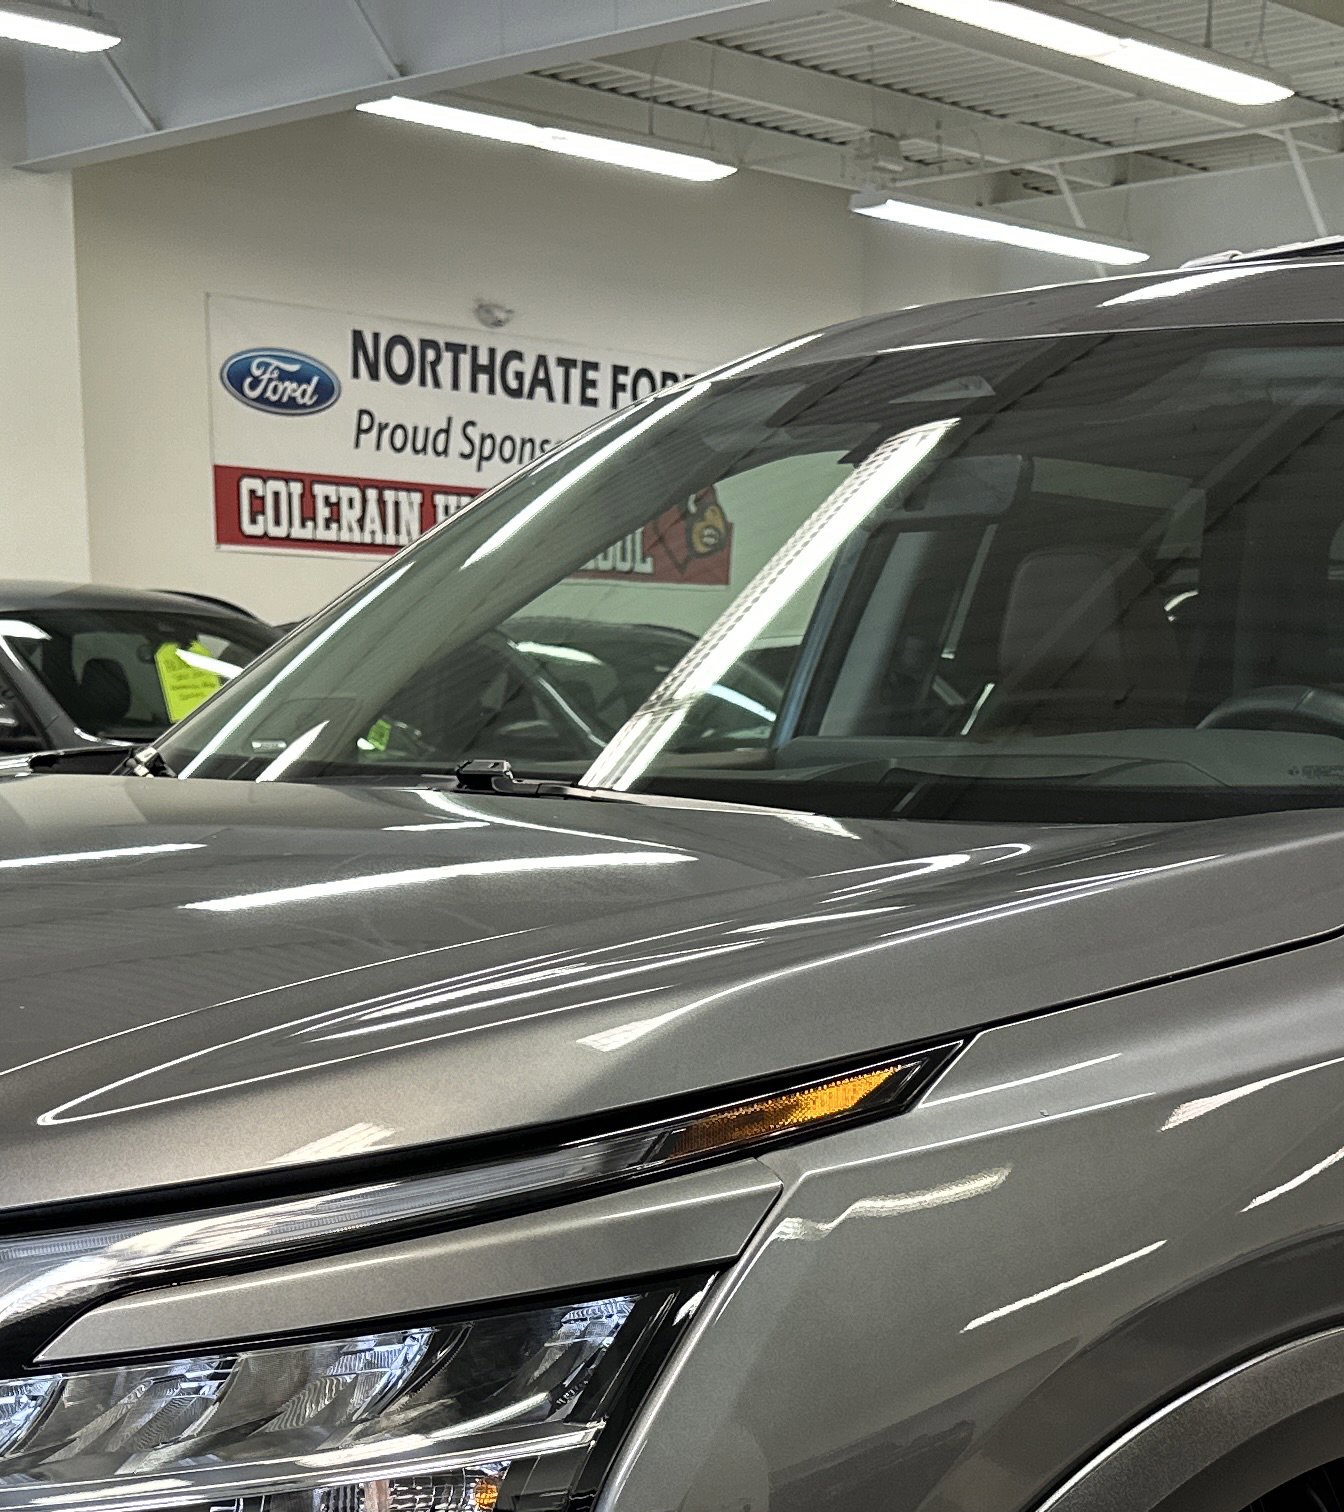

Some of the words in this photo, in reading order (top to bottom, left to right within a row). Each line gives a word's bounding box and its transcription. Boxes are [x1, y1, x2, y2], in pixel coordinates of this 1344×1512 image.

[241, 355, 320, 405] Ford
[351, 330, 600, 408] NORTHGATE
[611, 364, 696, 410] FO
[354, 410, 452, 459] Proud
[238, 476, 423, 547] COLERAIN
